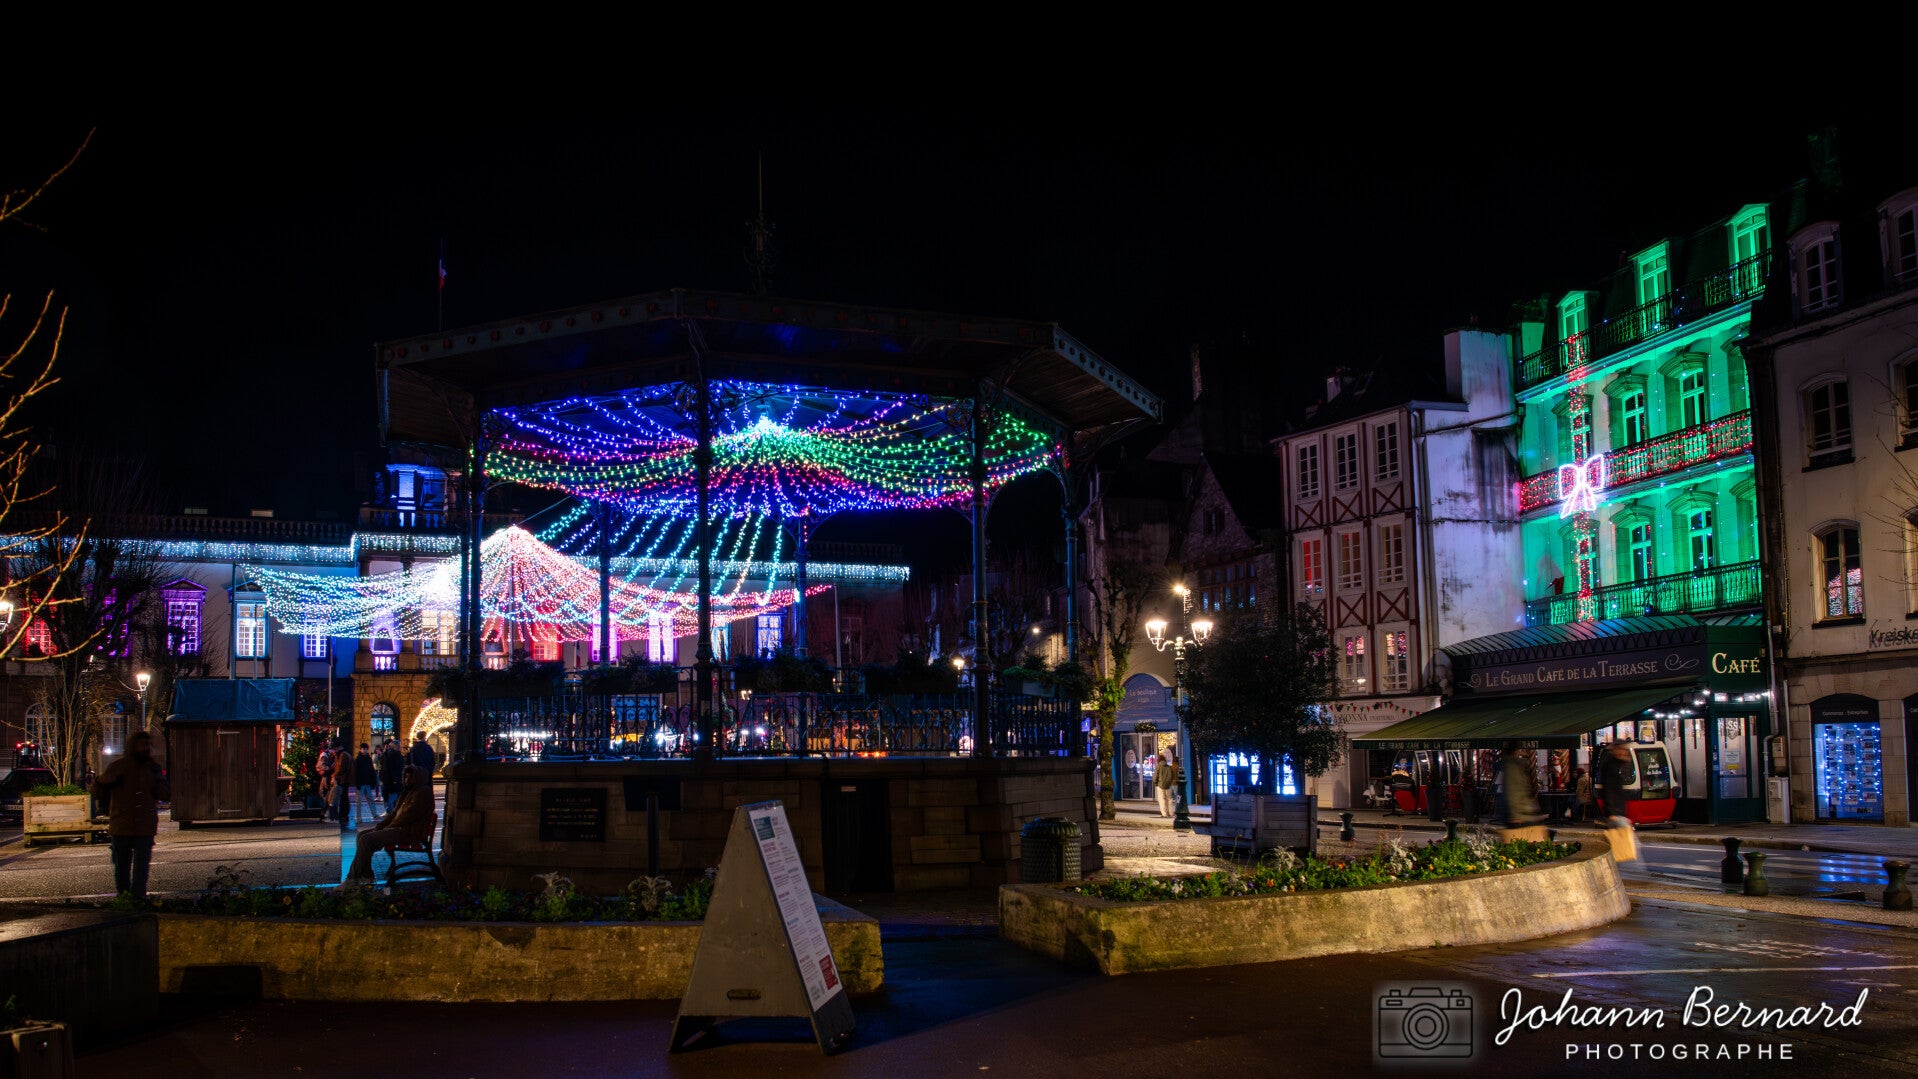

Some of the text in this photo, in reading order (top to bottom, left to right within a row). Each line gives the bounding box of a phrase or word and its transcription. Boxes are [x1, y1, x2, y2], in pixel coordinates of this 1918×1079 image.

[1485, 672, 1499, 688] LE
[1501, 670, 1535, 686] GRAND
[1567, 668, 1580, 680] DE
[1583, 667, 1597, 679] LA
[1598, 660, 1658, 678] TERRASSE
[1711, 652, 1761, 674] CAFÉ
